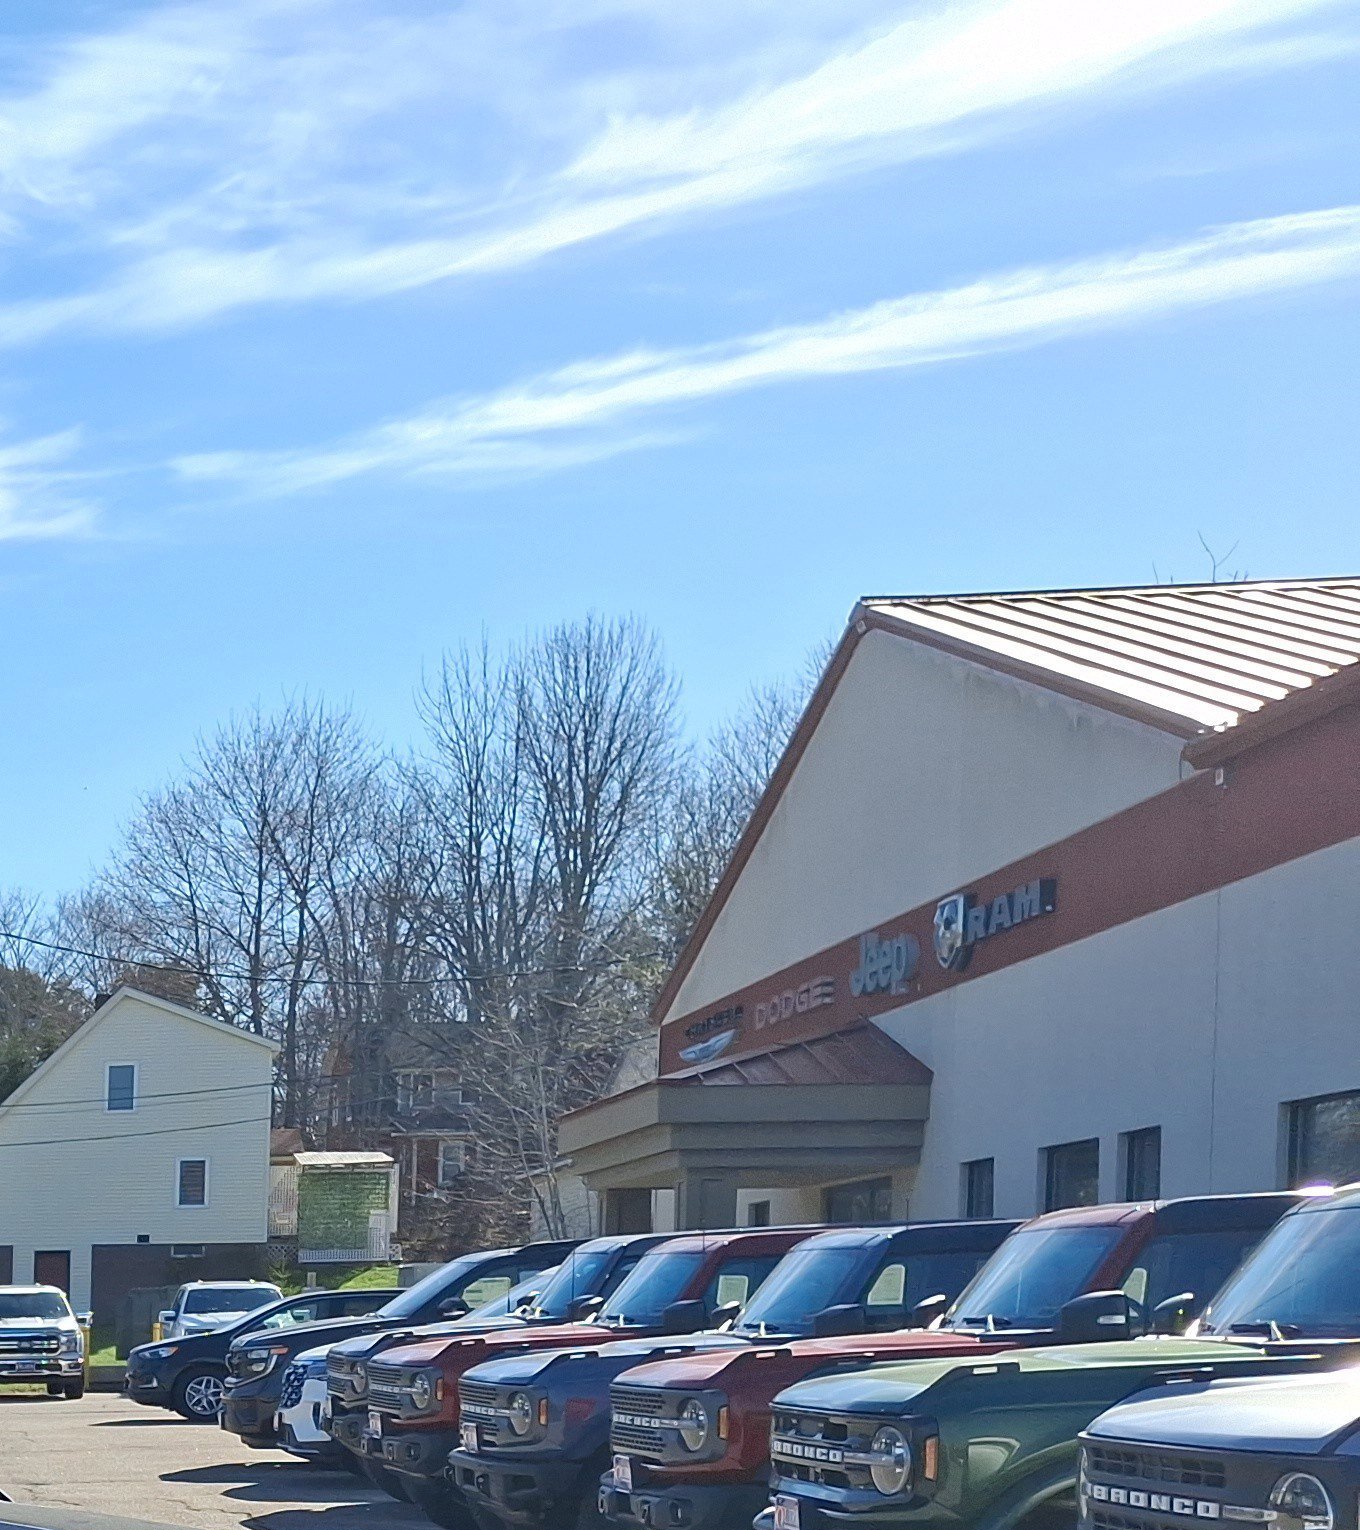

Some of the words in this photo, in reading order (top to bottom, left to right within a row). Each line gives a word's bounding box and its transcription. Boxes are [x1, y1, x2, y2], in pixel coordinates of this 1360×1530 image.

[966, 878, 1051, 945] RAM
[849, 933, 915, 996] Jeep
[755, 976, 836, 1030] DODGE
[773, 1440, 842, 1462] BRONCO
[1093, 1484, 1220, 1519] BRONCO
